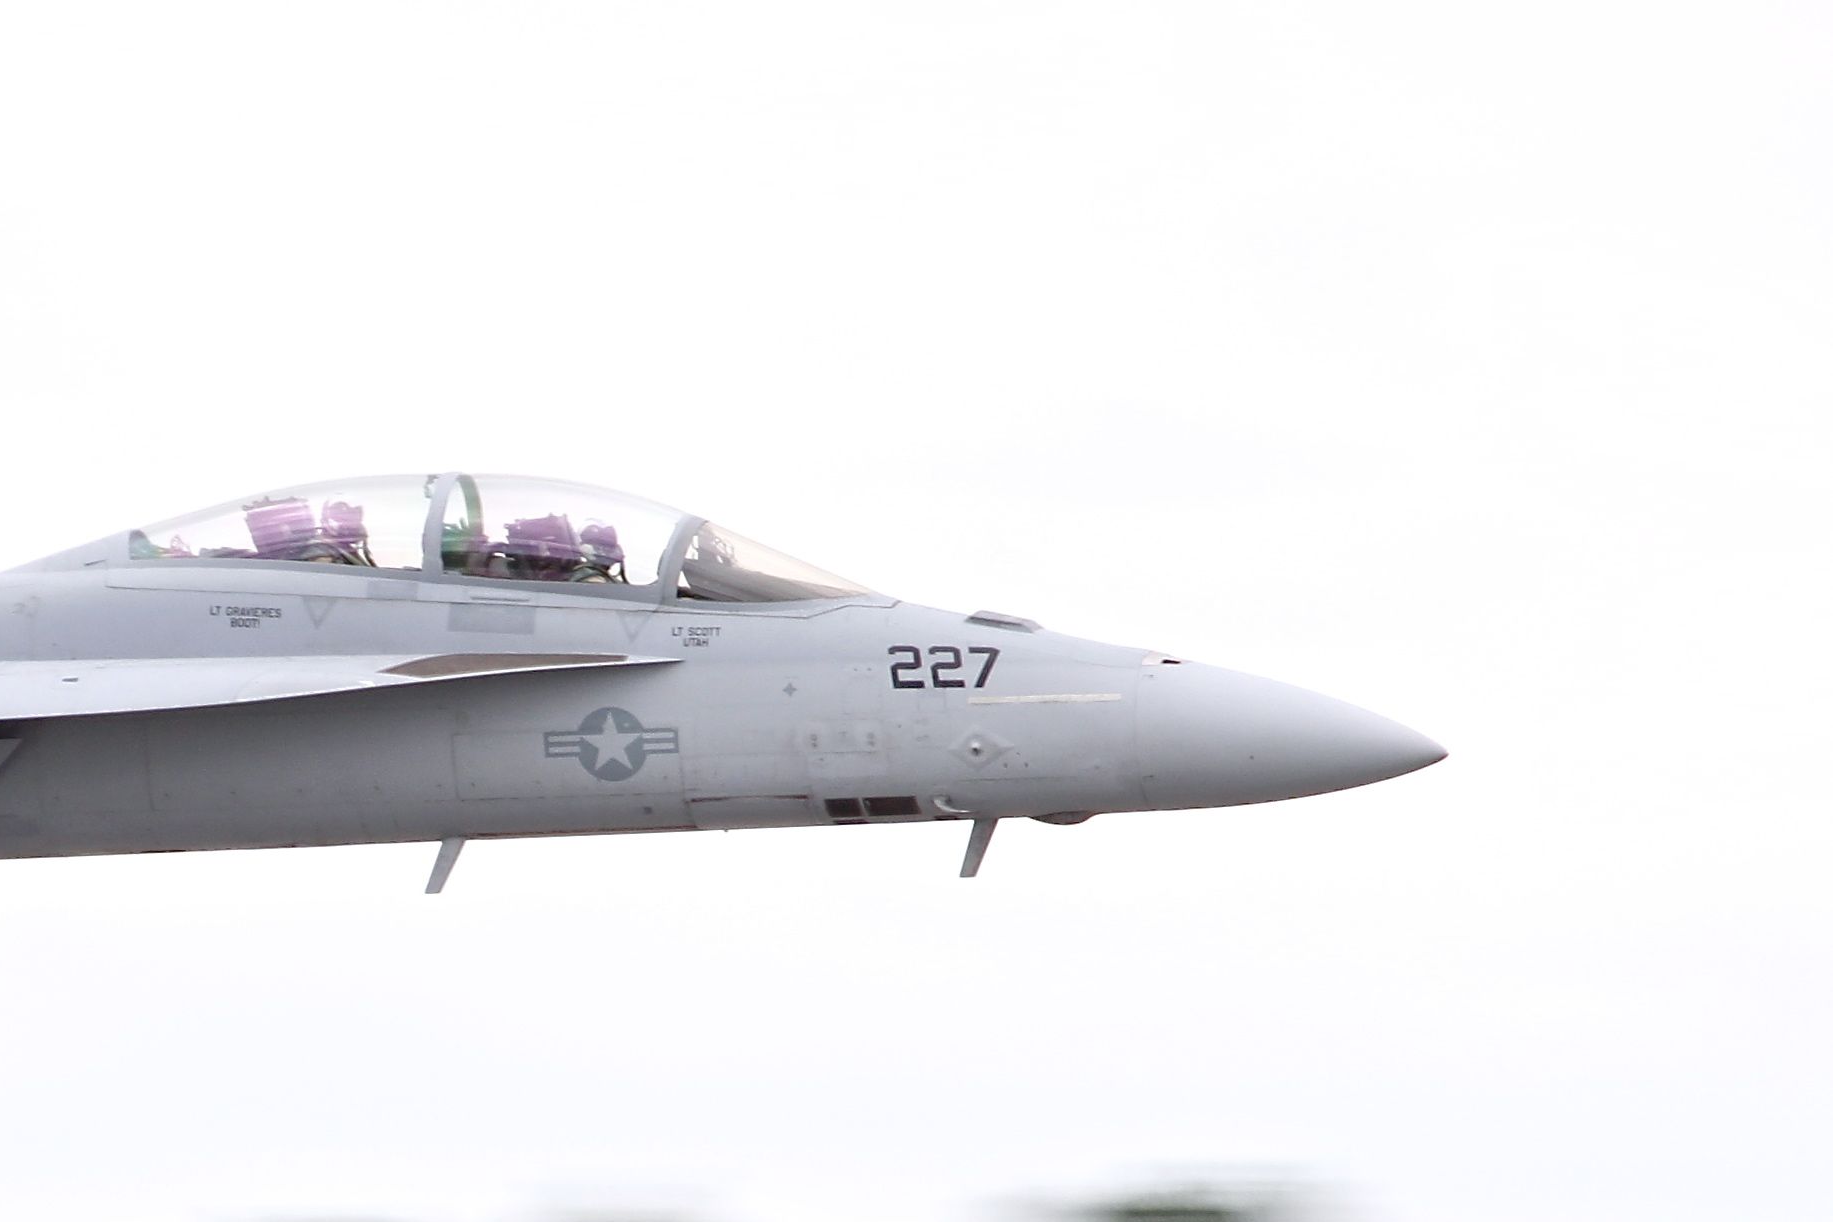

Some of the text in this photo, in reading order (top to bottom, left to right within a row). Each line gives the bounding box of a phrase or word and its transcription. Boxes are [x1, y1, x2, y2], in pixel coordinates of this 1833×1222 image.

[209, 605, 222, 616] LT
[670, 626, 722, 637] LT SCOTT
[683, 637, 709, 648] UTAH
[887, 645, 1001, 689] 227
